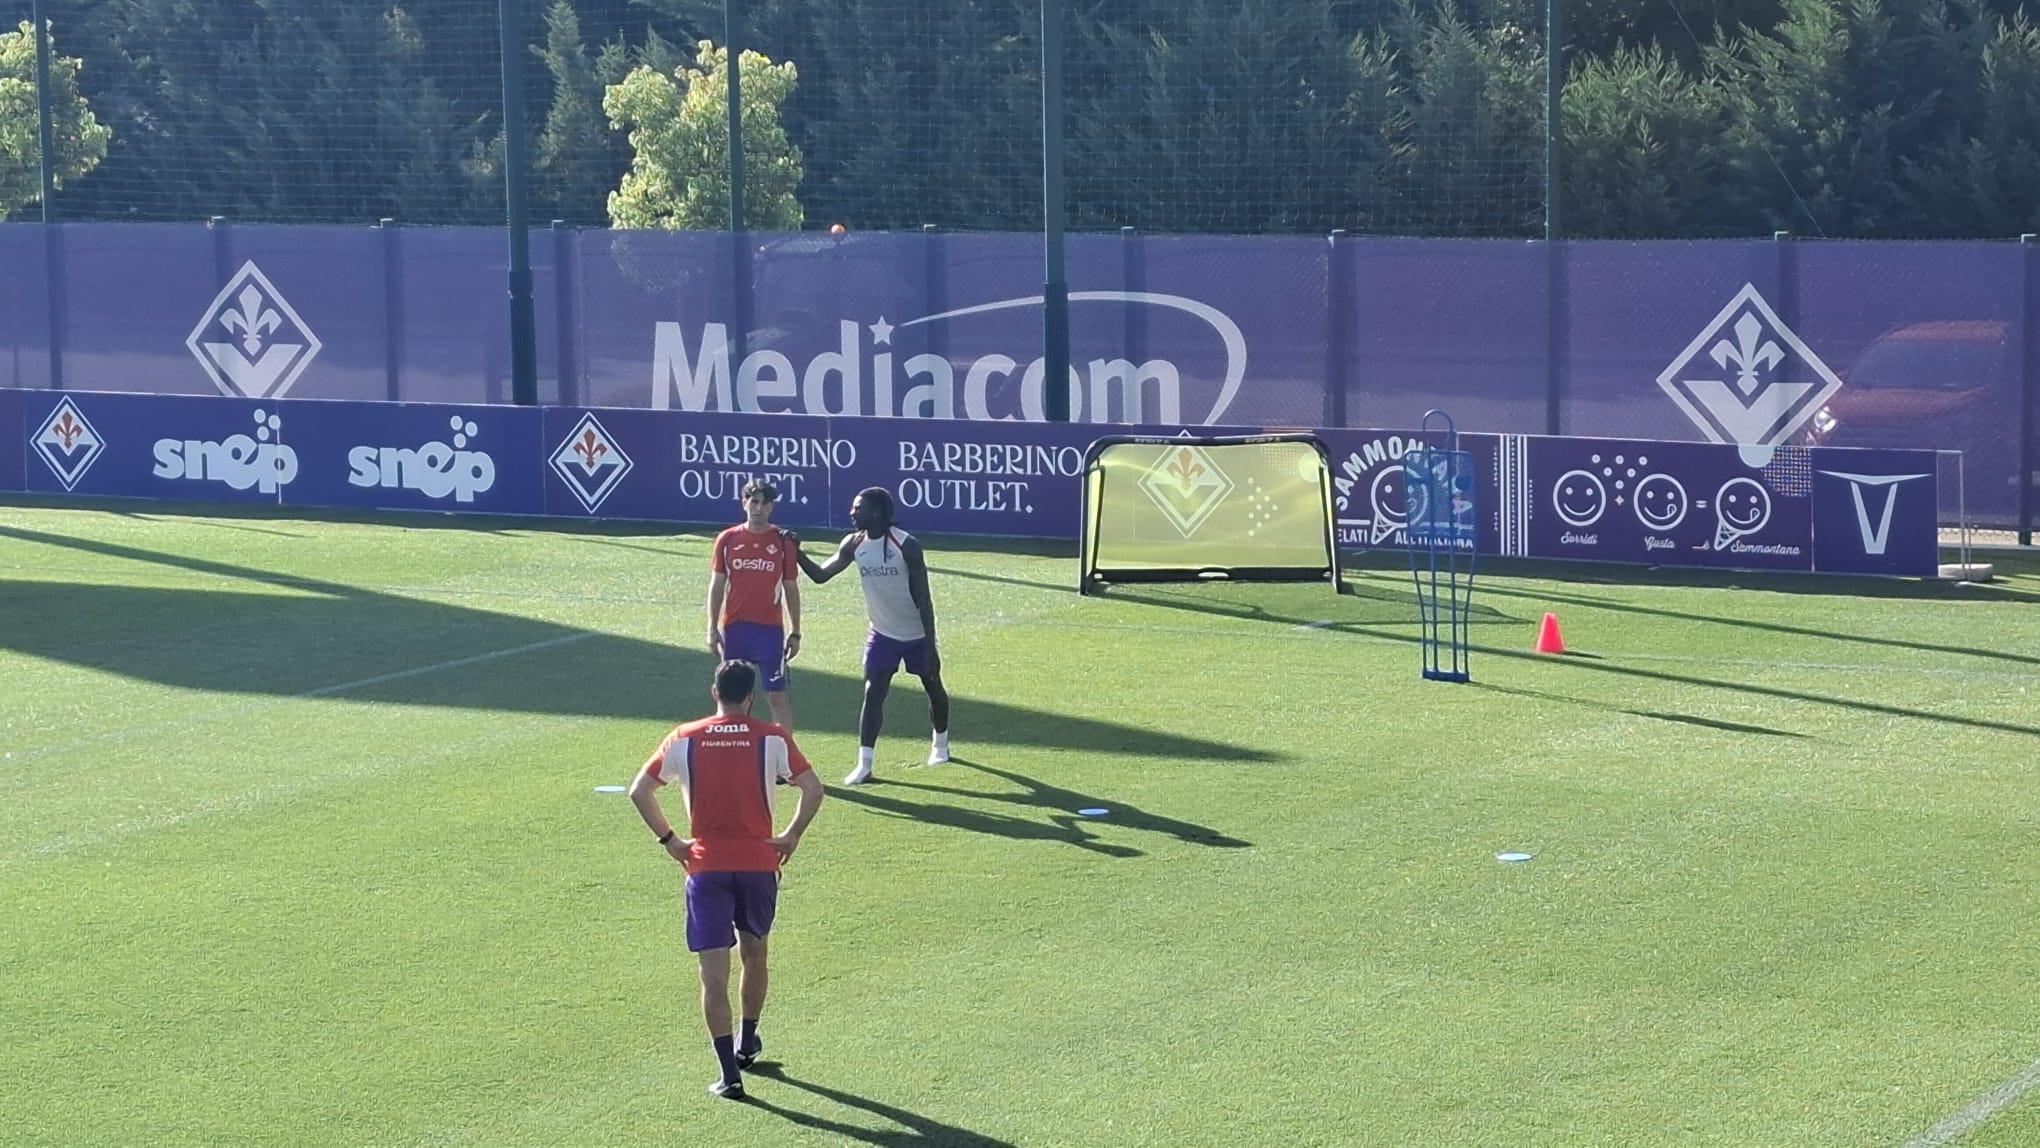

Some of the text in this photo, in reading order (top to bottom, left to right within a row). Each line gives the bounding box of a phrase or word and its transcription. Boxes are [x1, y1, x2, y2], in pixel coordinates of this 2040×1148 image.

[651, 319, 1181, 425] Mediacom
[152, 434, 298, 493] snep
[680, 433, 857, 469] BARBERINO
[898, 441, 1083, 477] BARBERINO
[348, 441, 496, 502] snep
[680, 469, 809, 505] OUTET.
[898, 478, 1035, 514] OUTLET.
[1560, 531, 1598, 545] Sorridi
[1730, 539, 1801, 555] Sammontana
